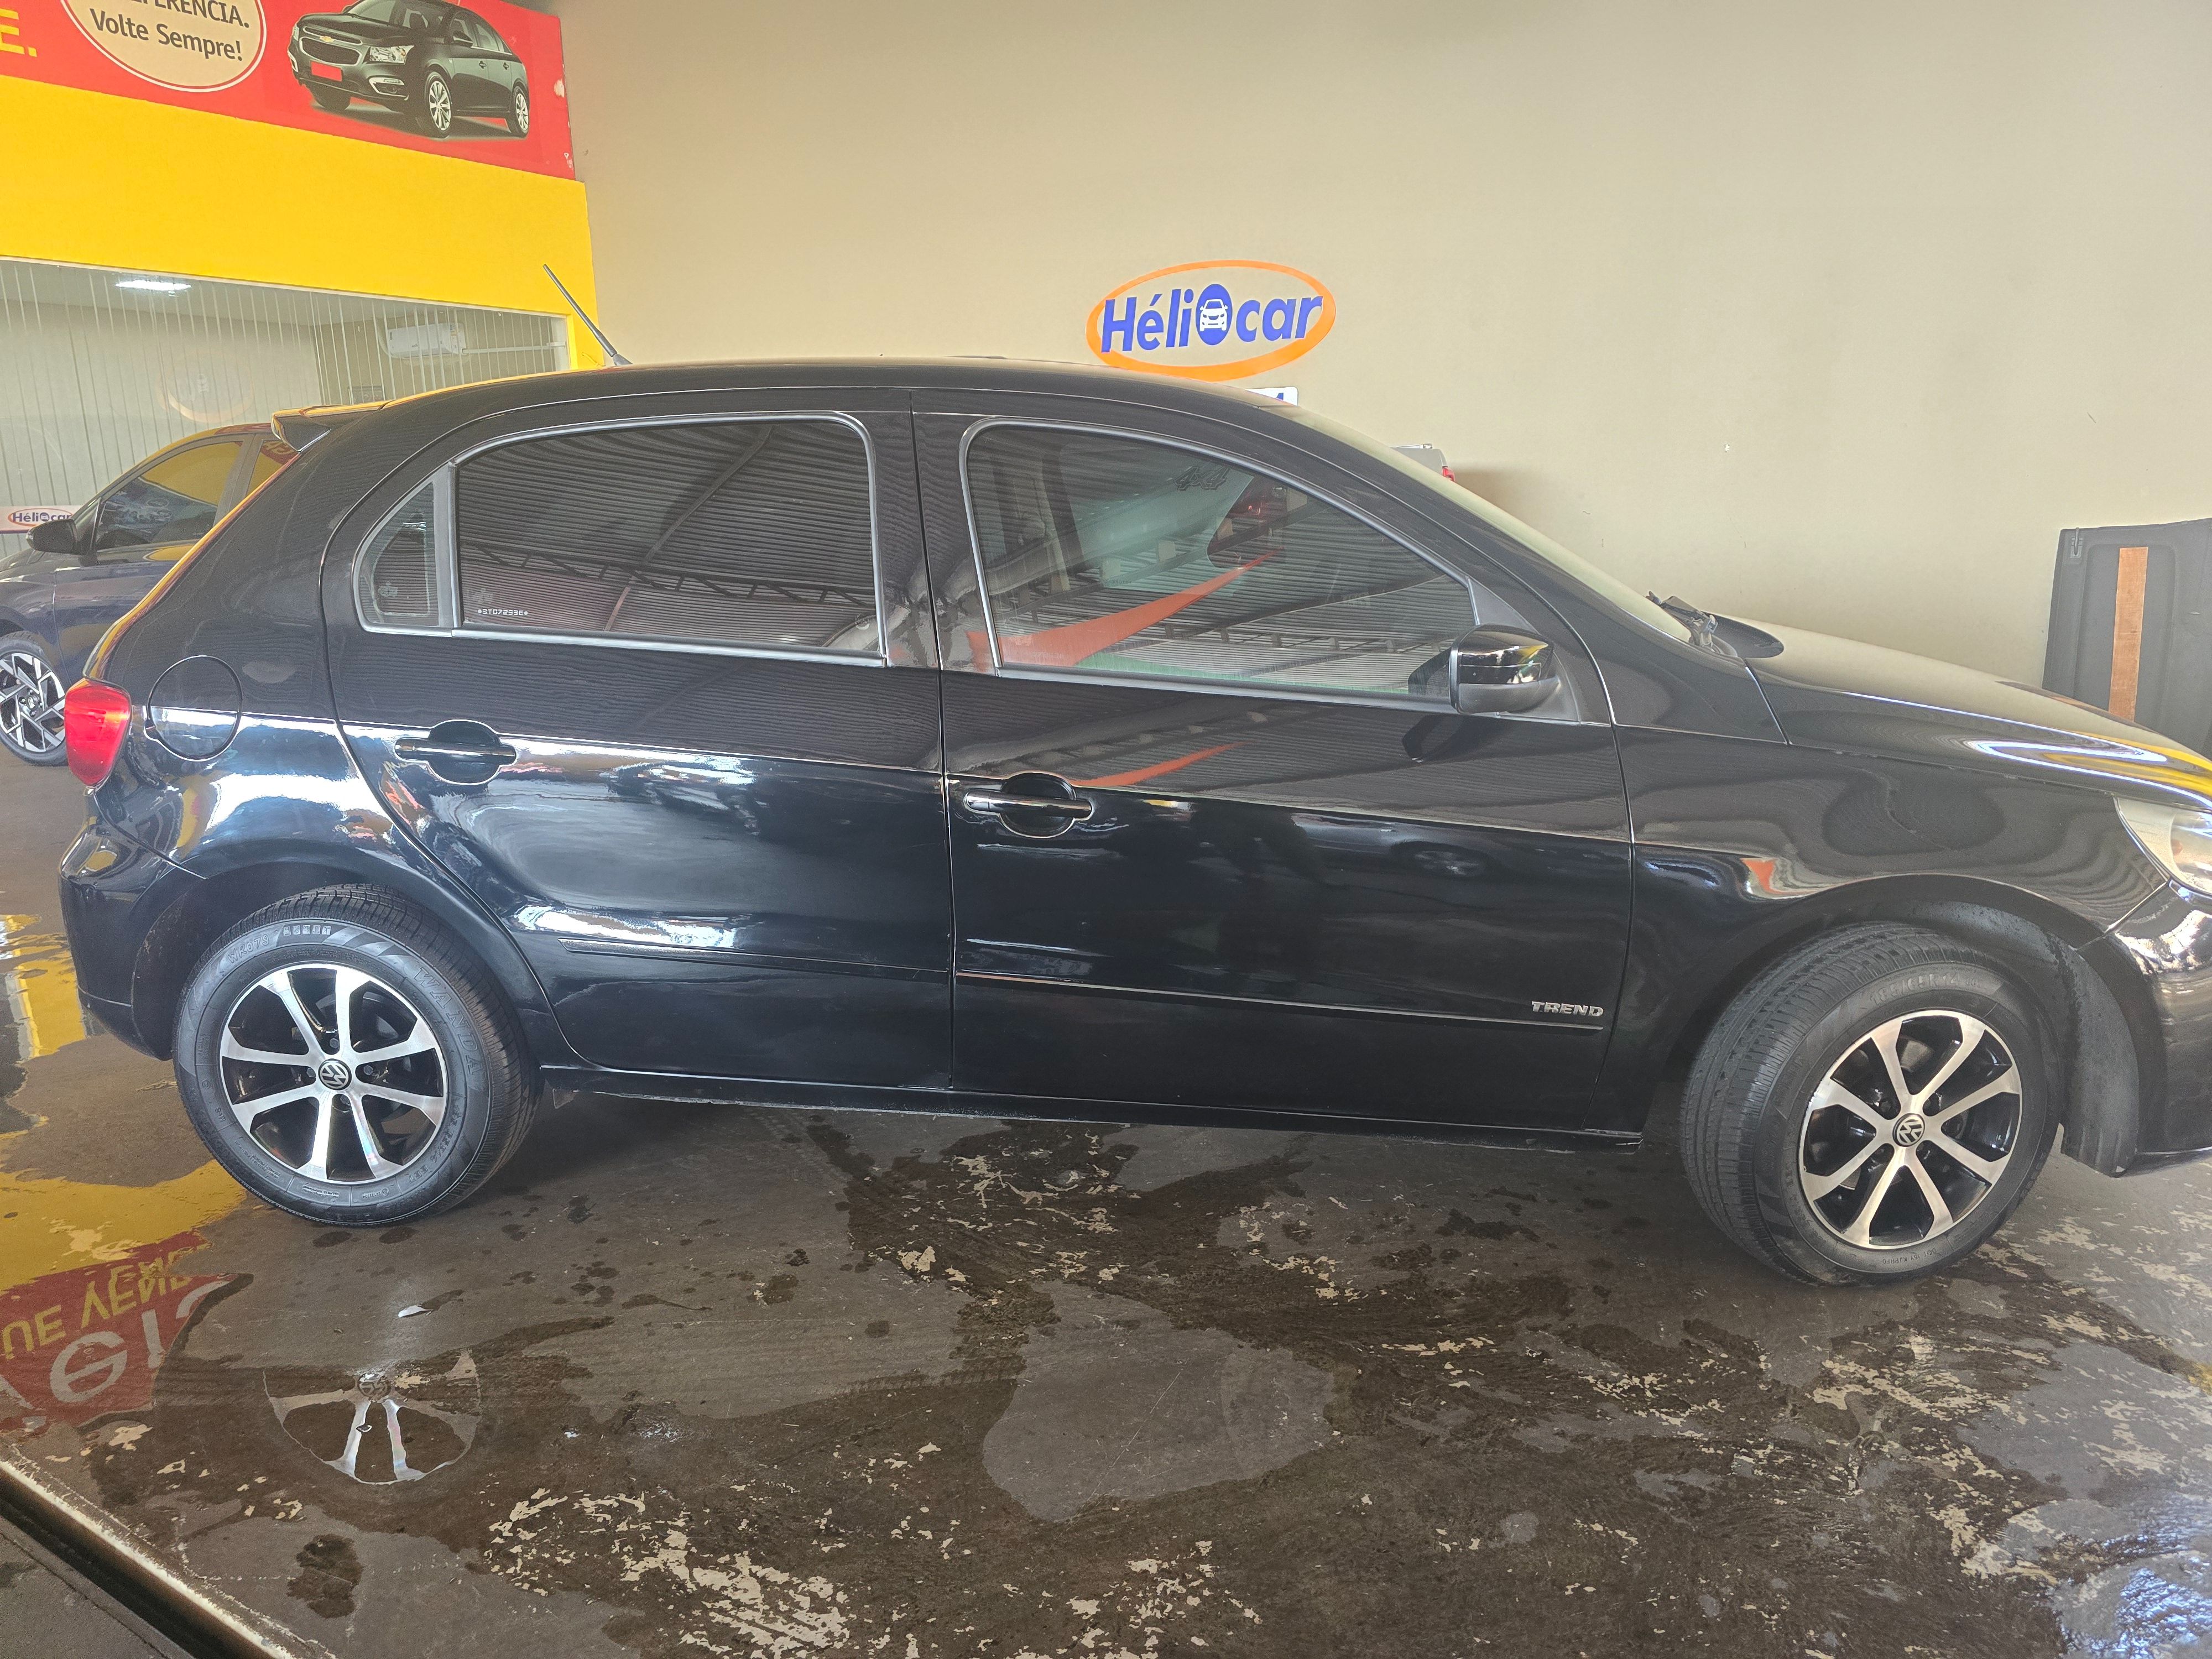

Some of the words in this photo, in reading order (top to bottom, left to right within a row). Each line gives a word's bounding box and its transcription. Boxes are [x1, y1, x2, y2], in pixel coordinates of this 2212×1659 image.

[90, 8, 149, 40] Volte
[156, 23, 243, 61] Sempre!
[414, 967, 484, 1074] WANDA
[1531, 1001, 1604, 1016] TREND
